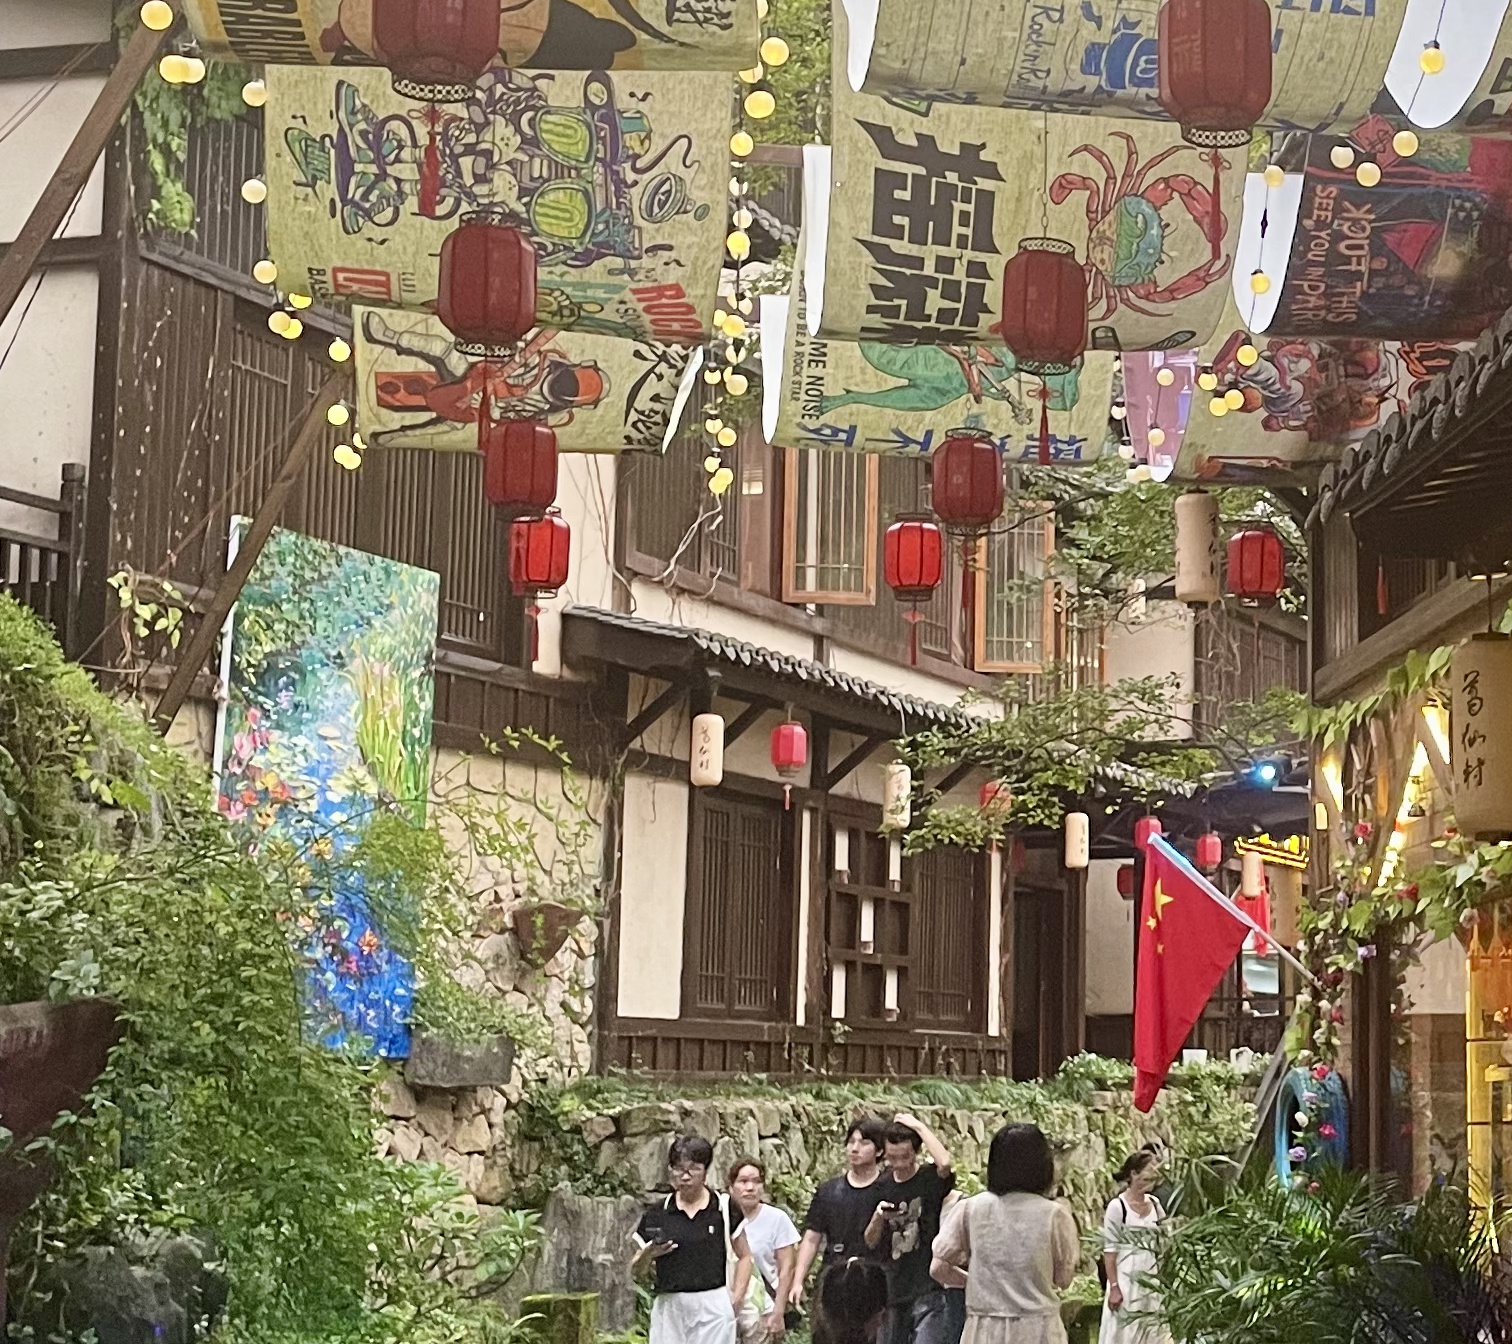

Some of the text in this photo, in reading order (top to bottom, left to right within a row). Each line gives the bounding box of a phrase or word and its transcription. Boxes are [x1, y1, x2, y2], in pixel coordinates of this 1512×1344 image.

[1312, 184, 1339, 222] SEE
[1308, 229, 1331, 261] YOU
[796, 324, 807, 338] BE
[795, 340, 805, 348] A
[792, 351, 805, 376] ROCK
[791, 380, 801, 402] STAR
[801, 375, 825, 420] NOISE
